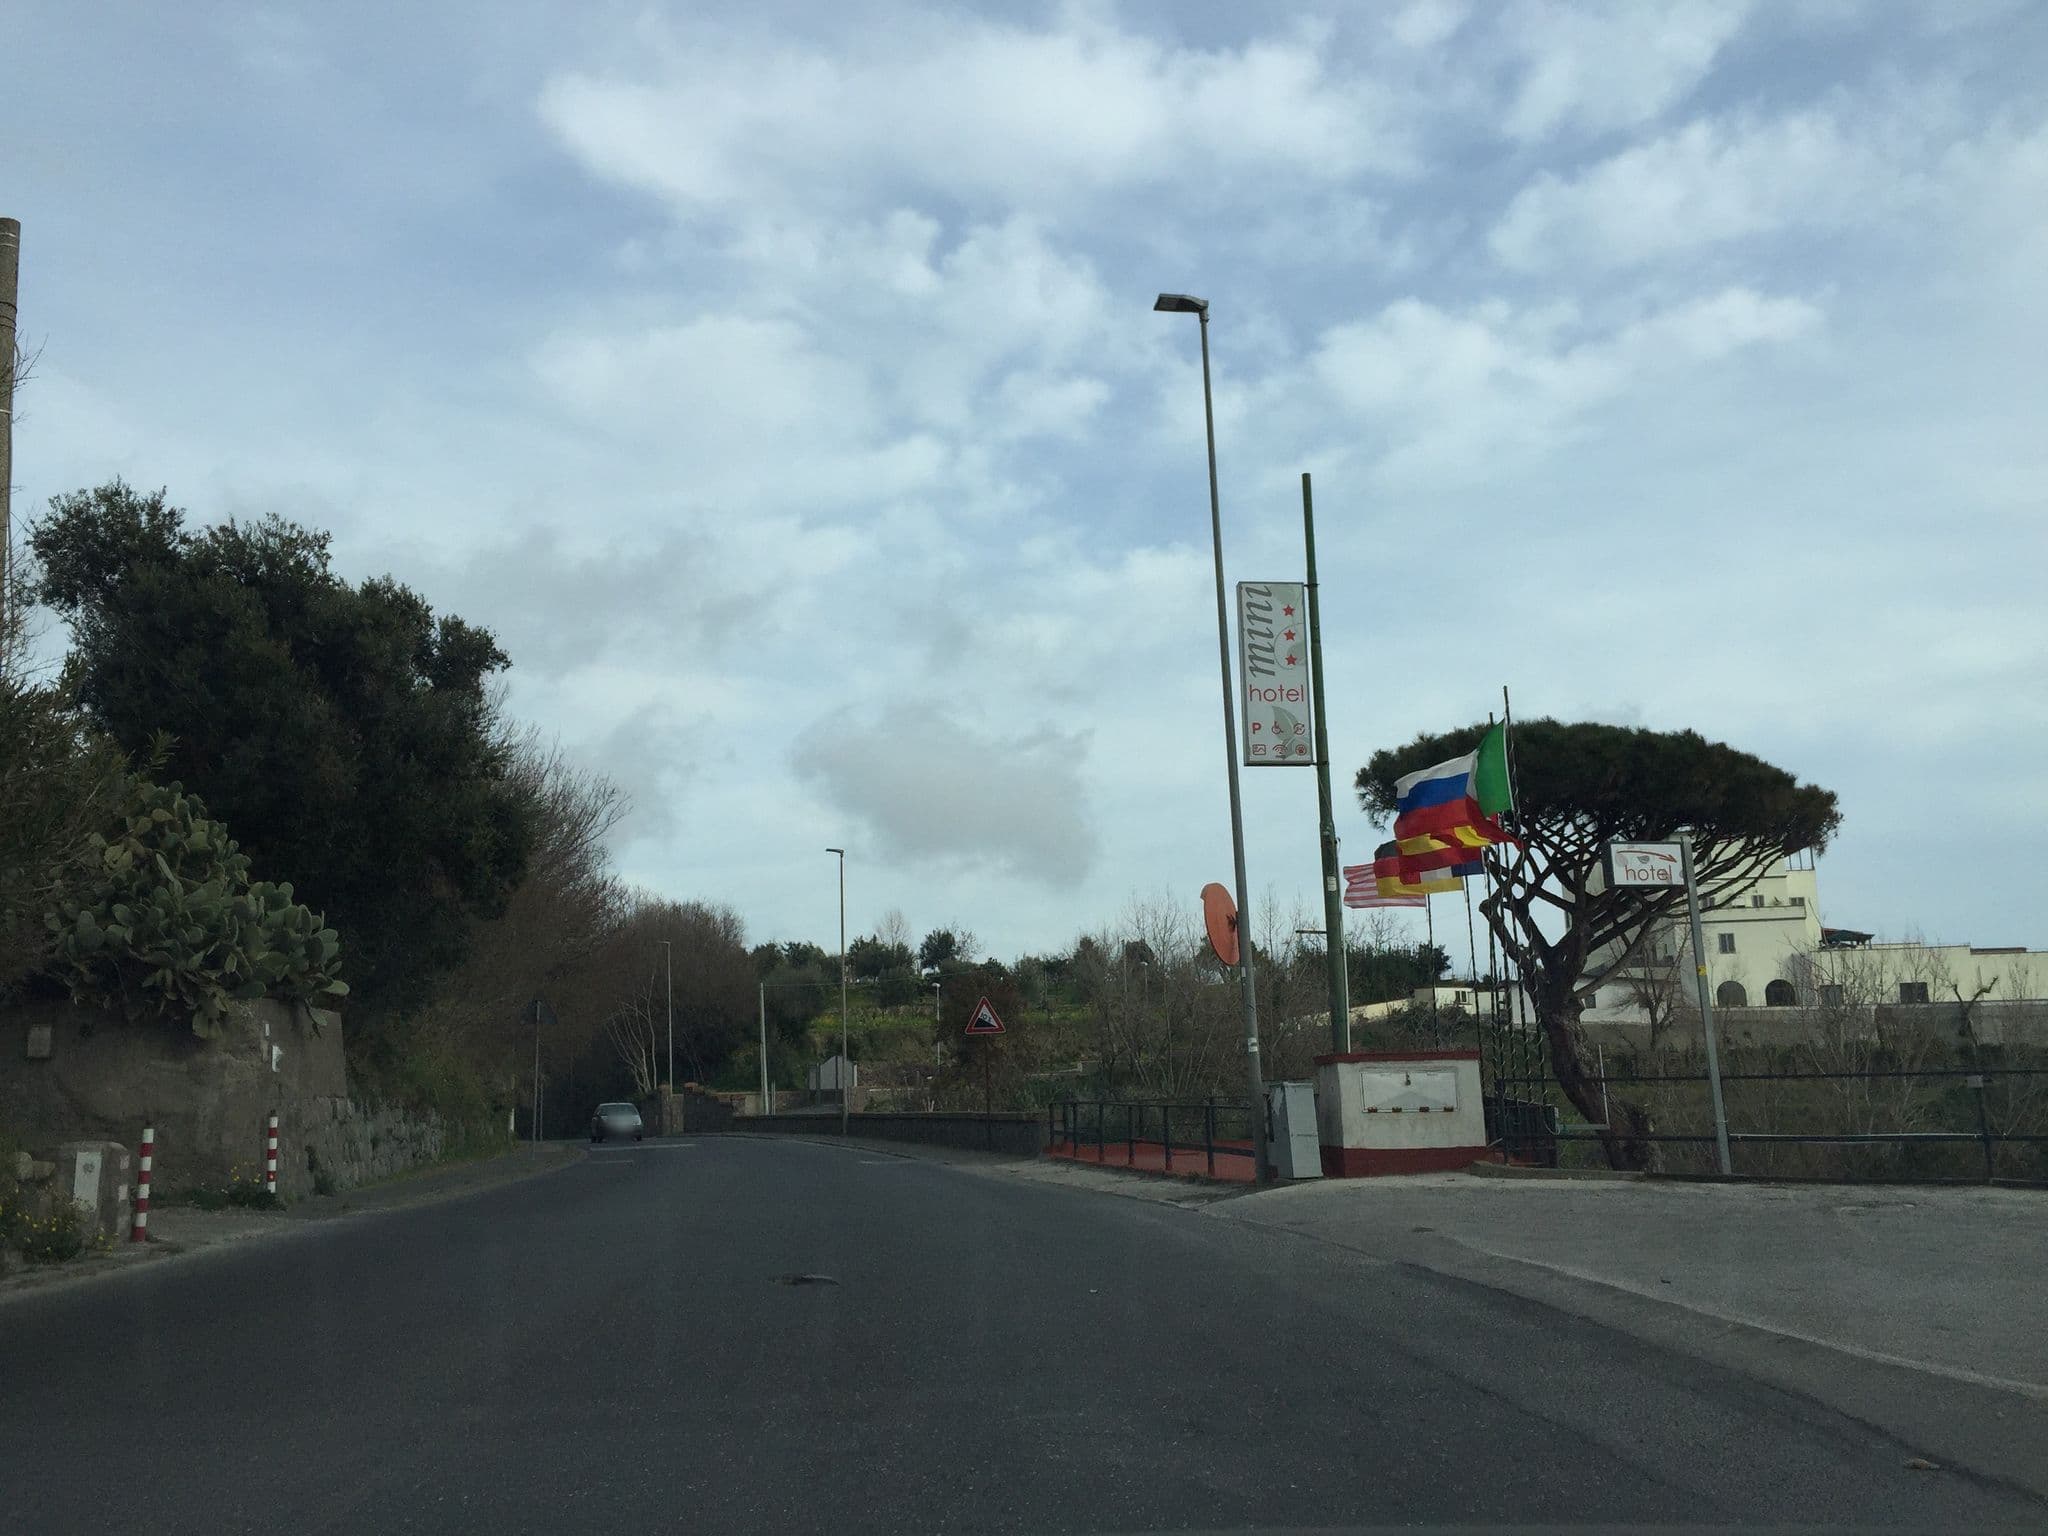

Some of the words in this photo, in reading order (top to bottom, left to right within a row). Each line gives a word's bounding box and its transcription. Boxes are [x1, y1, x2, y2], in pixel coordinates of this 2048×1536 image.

[1245, 585, 1275, 678] mini
[1249, 685, 1304, 702] hotel
[1252, 722, 1261, 734] P
[1625, 864, 1673, 880] hotel
